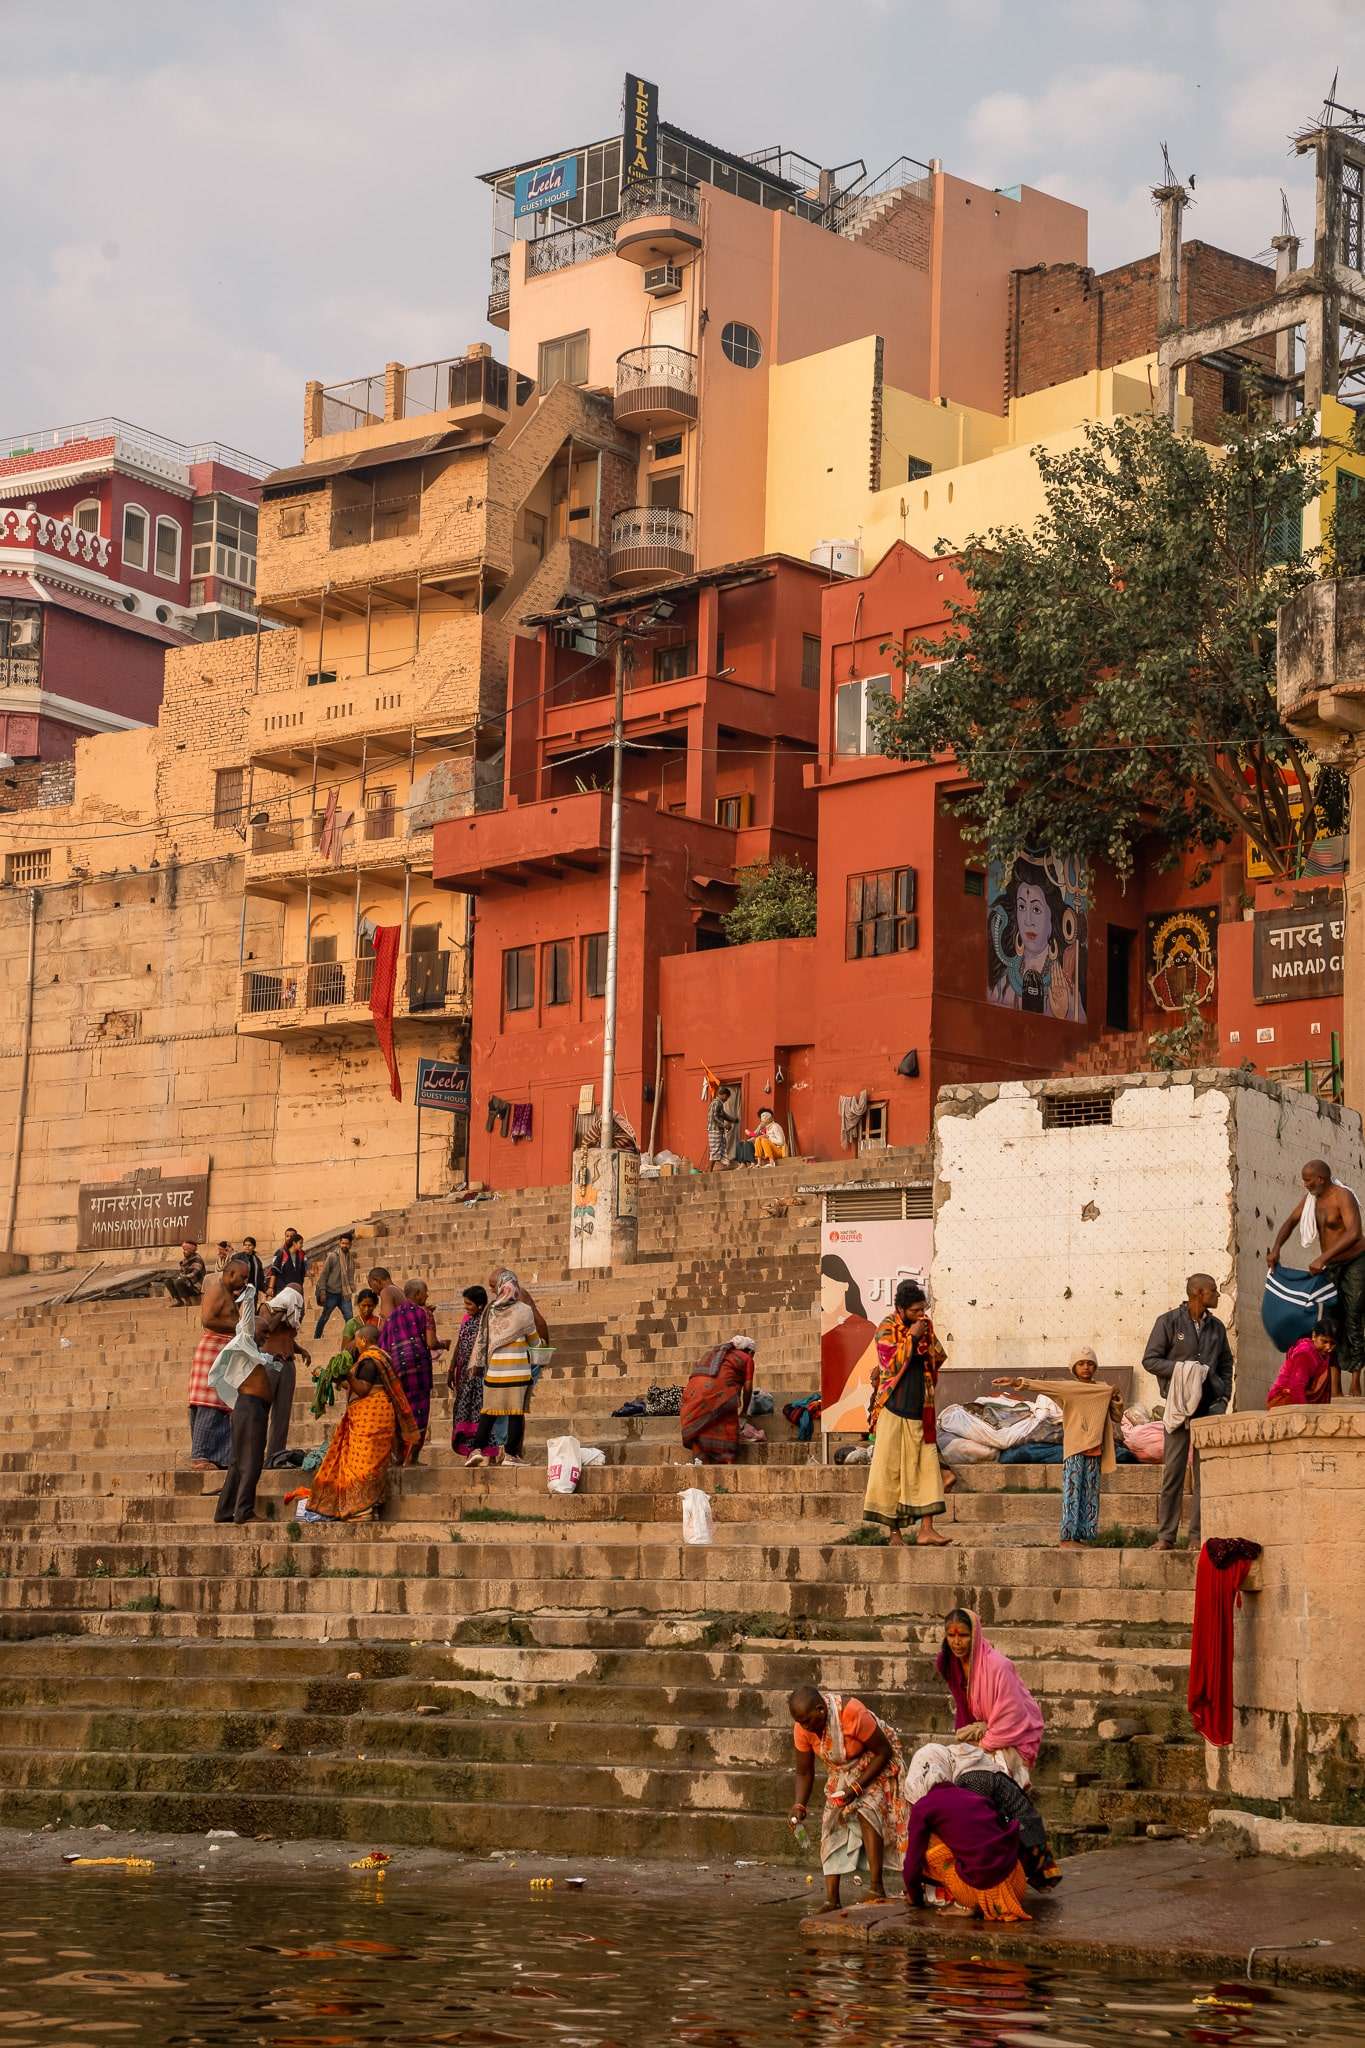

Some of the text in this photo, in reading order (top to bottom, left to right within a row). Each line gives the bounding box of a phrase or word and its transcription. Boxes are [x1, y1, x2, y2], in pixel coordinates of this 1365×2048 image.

[633, 80, 649, 171] LEELA
[527, 166, 562, 199] Leela
[520, 190, 571, 212] GUEST HOUSE
[1269, 923, 1324, 950] नारद
[1272, 958, 1326, 979] NARAD
[424, 1063, 465, 1091] Leela
[421, 1091, 468, 1104] GUEST HOUSE
[90, 1188, 194, 1213] मानसरोवर घाट
[92, 1216, 189, 1233] MANSAROVAR GHAT
